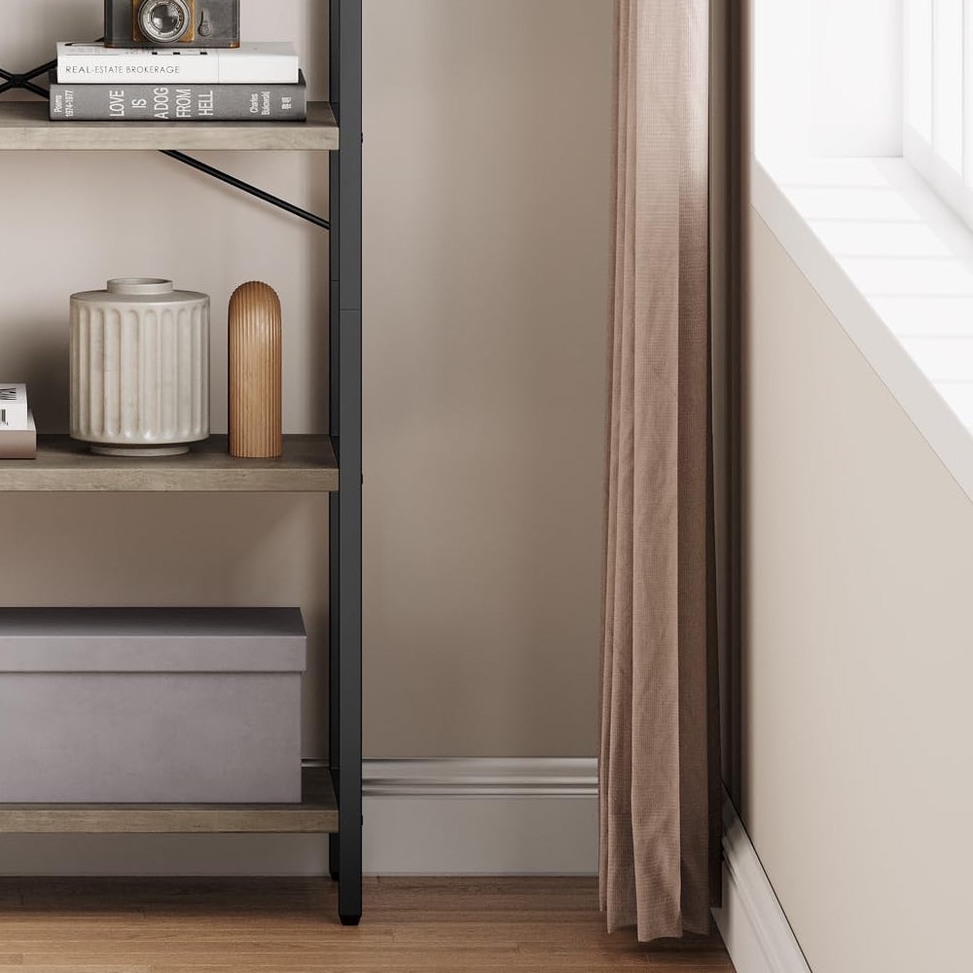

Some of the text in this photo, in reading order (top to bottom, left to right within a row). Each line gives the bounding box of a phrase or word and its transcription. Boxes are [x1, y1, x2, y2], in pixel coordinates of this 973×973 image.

[65, 65, 180, 74] REAL-ESTATE BROKERAGE
[54, 94, 62, 113] Poems
[109, 90, 124, 117] LOVE
[132, 98, 147, 109] IS
[153, 87, 168, 119] A DOG
[176, 88, 191, 118] FROM
[198, 90, 213, 116] HELL
[250, 93, 258, 114] Charles
[261, 91, 270, 116] Bukowski
